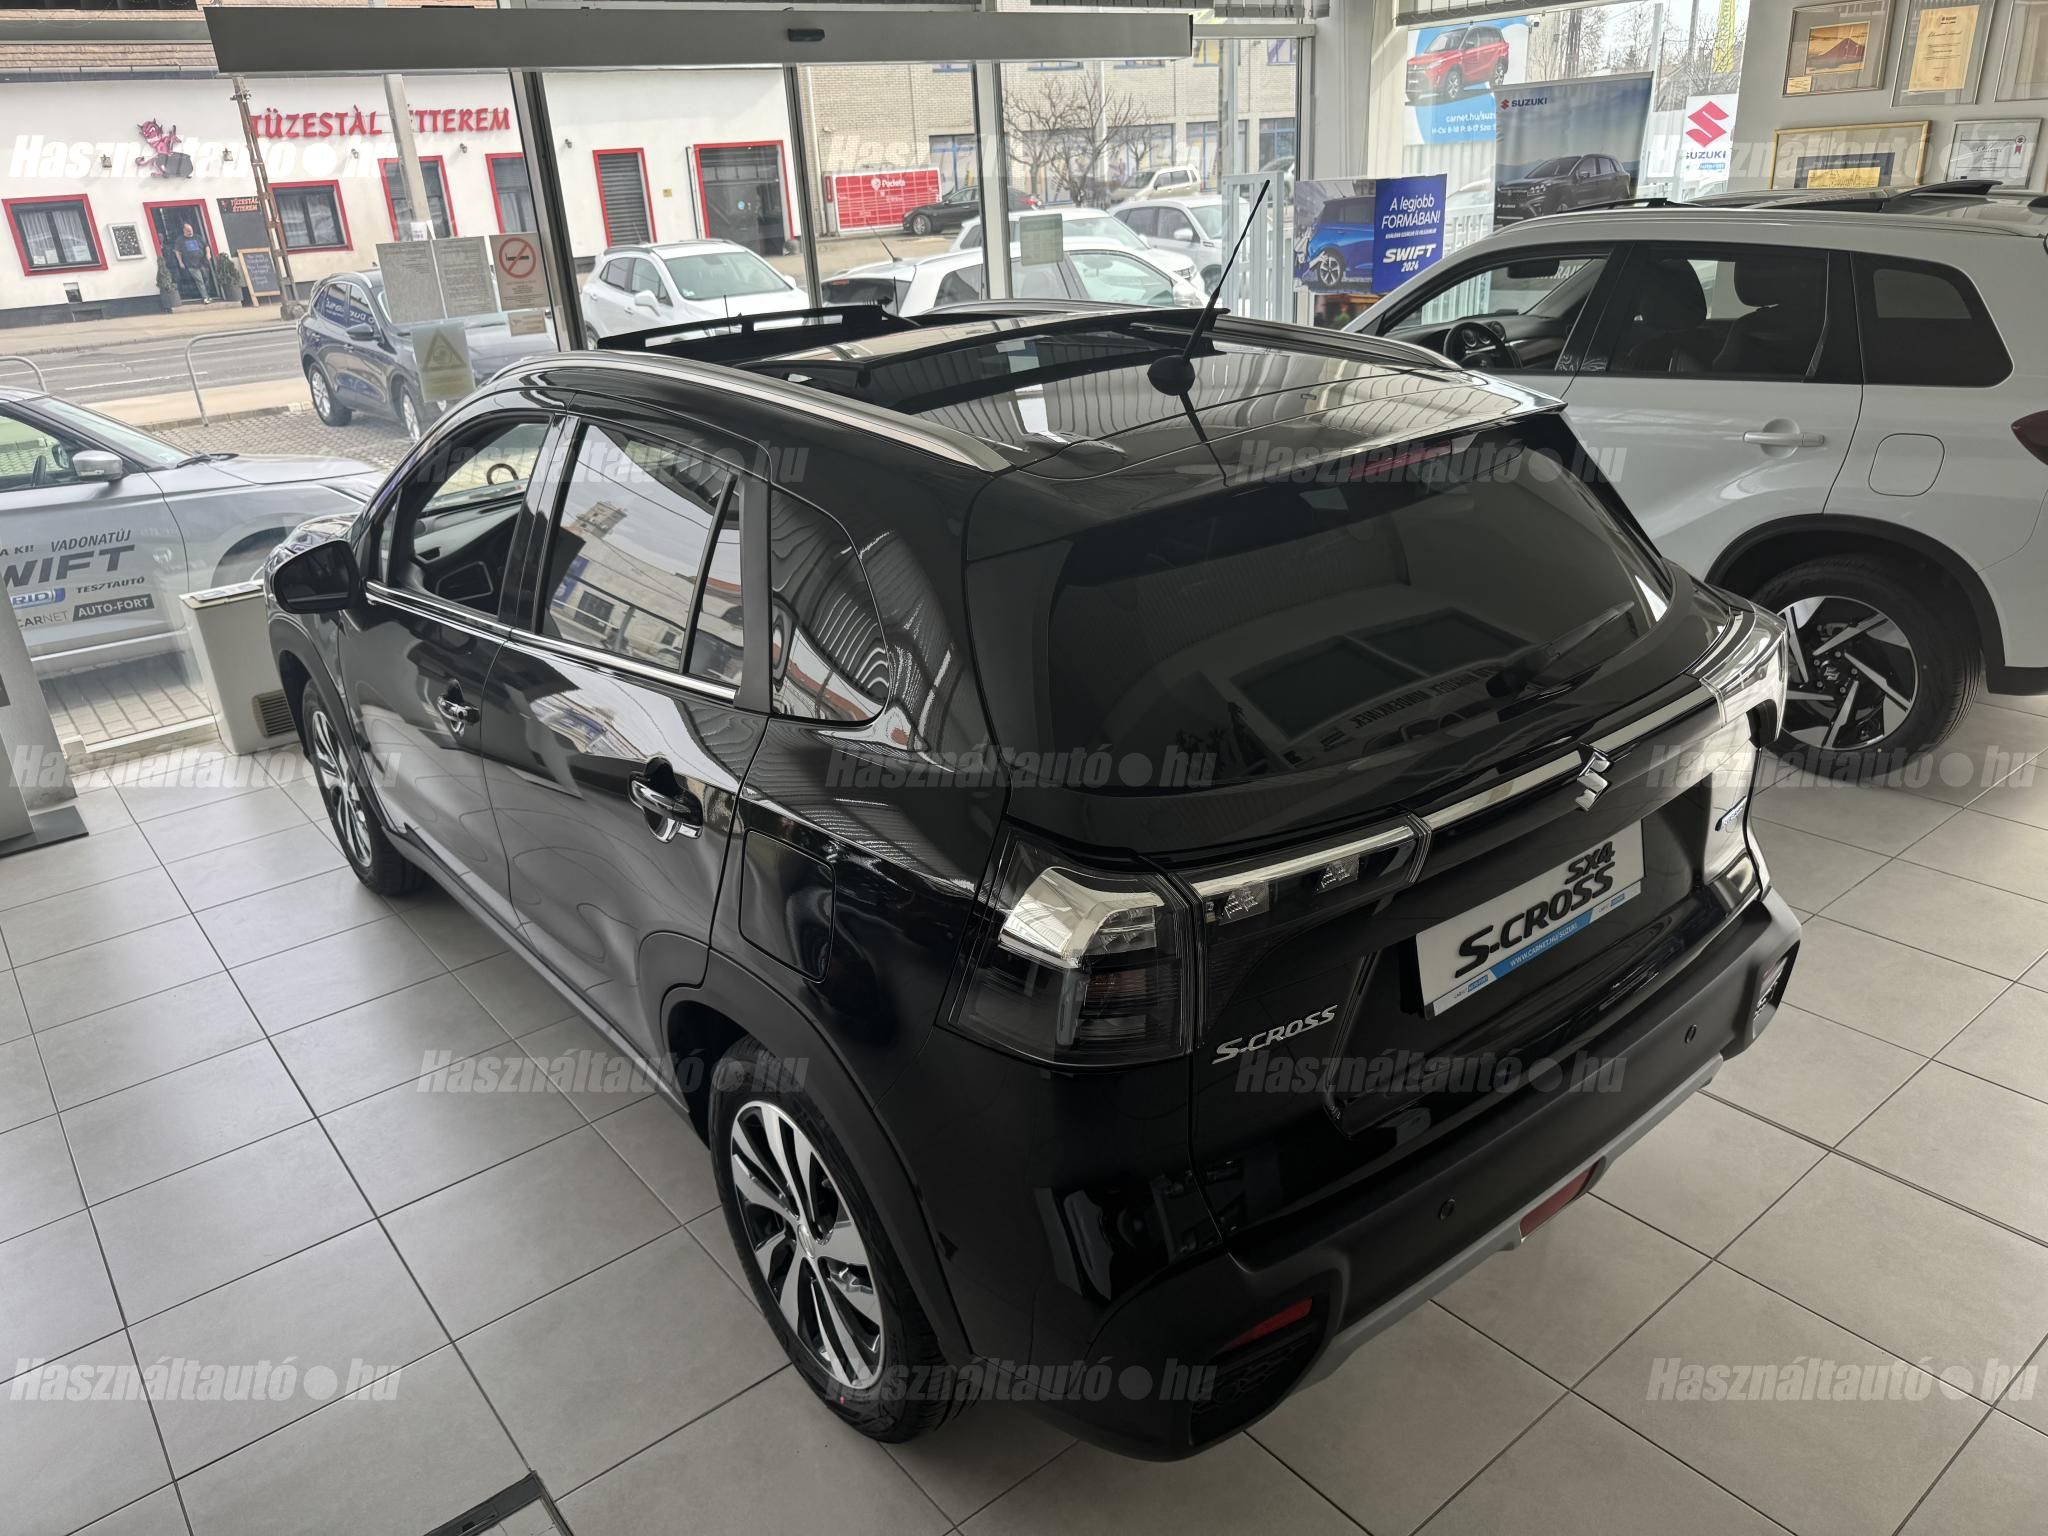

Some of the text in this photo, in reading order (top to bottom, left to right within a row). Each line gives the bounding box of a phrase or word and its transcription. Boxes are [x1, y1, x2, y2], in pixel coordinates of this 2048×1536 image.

[1511, 97, 1547, 108] SUZUKI
[407, 104, 510, 133] TTEREM
[1389, 193, 1434, 212] A legjobb
[1381, 209, 1440, 229] FORMÁBAN!
[1383, 243, 1436, 263] SWIFT
[1401, 261, 1419, 272] 2024
[51, 528, 131, 553] VADONATÚJ
[77, 576, 145, 594] TESZTAUTÓ
[78, 597, 149, 618] AUTO-FORT
[1564, 841, 1616, 885] SX4
[1454, 862, 1616, 979] S-CROSS
[1211, 1004, 1338, 1064] S-CROSS
